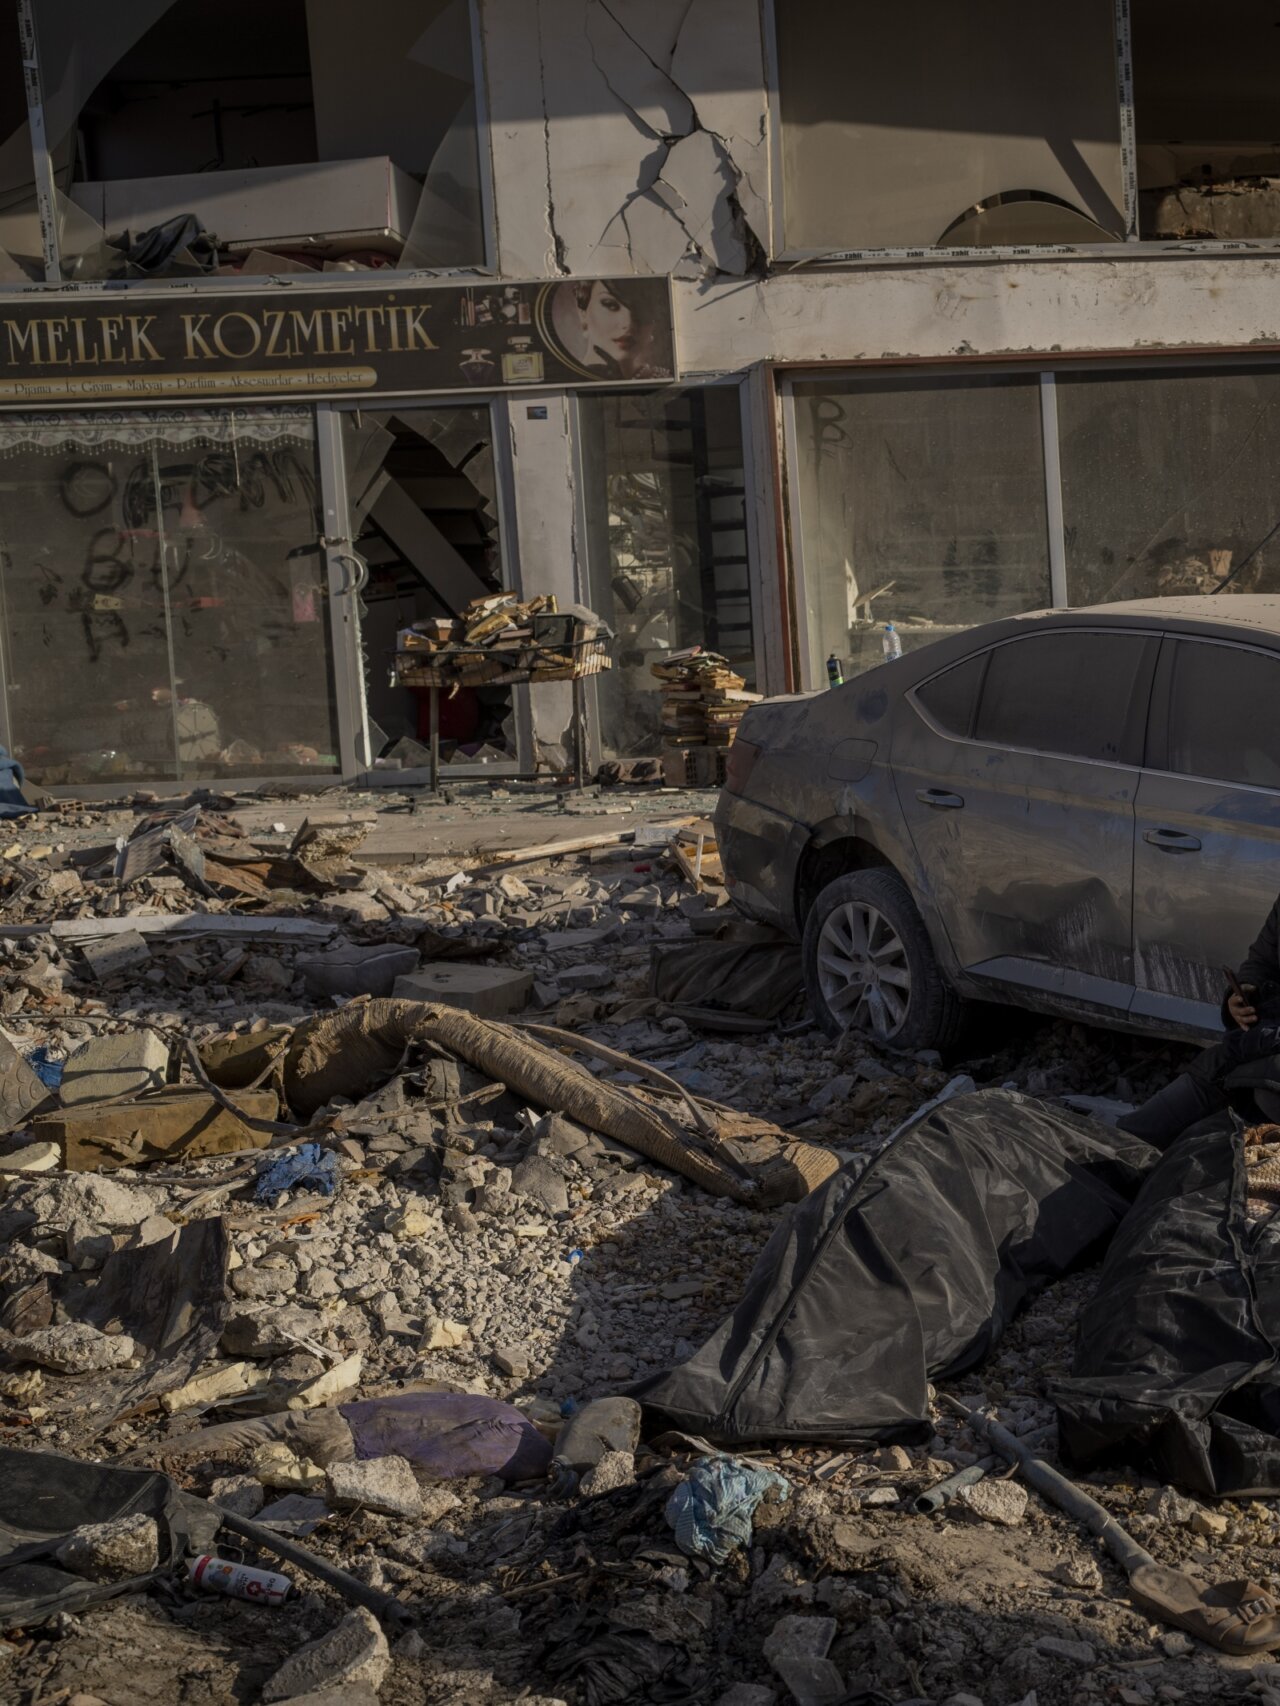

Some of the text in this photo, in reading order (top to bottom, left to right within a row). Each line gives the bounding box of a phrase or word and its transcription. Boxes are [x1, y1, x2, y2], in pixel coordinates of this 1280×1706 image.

[3, 294, 439, 366] MELEK KOZMETİK
[15, 383, 51, 397] Pijama
[82, 380, 113, 396] Giyim
[127, 379, 163, 394] Makyaj
[176, 376, 216, 389] Parfüm
[229, 374, 293, 387] Aksesuarlar
[307, 371, 363, 387] Hediyeler
